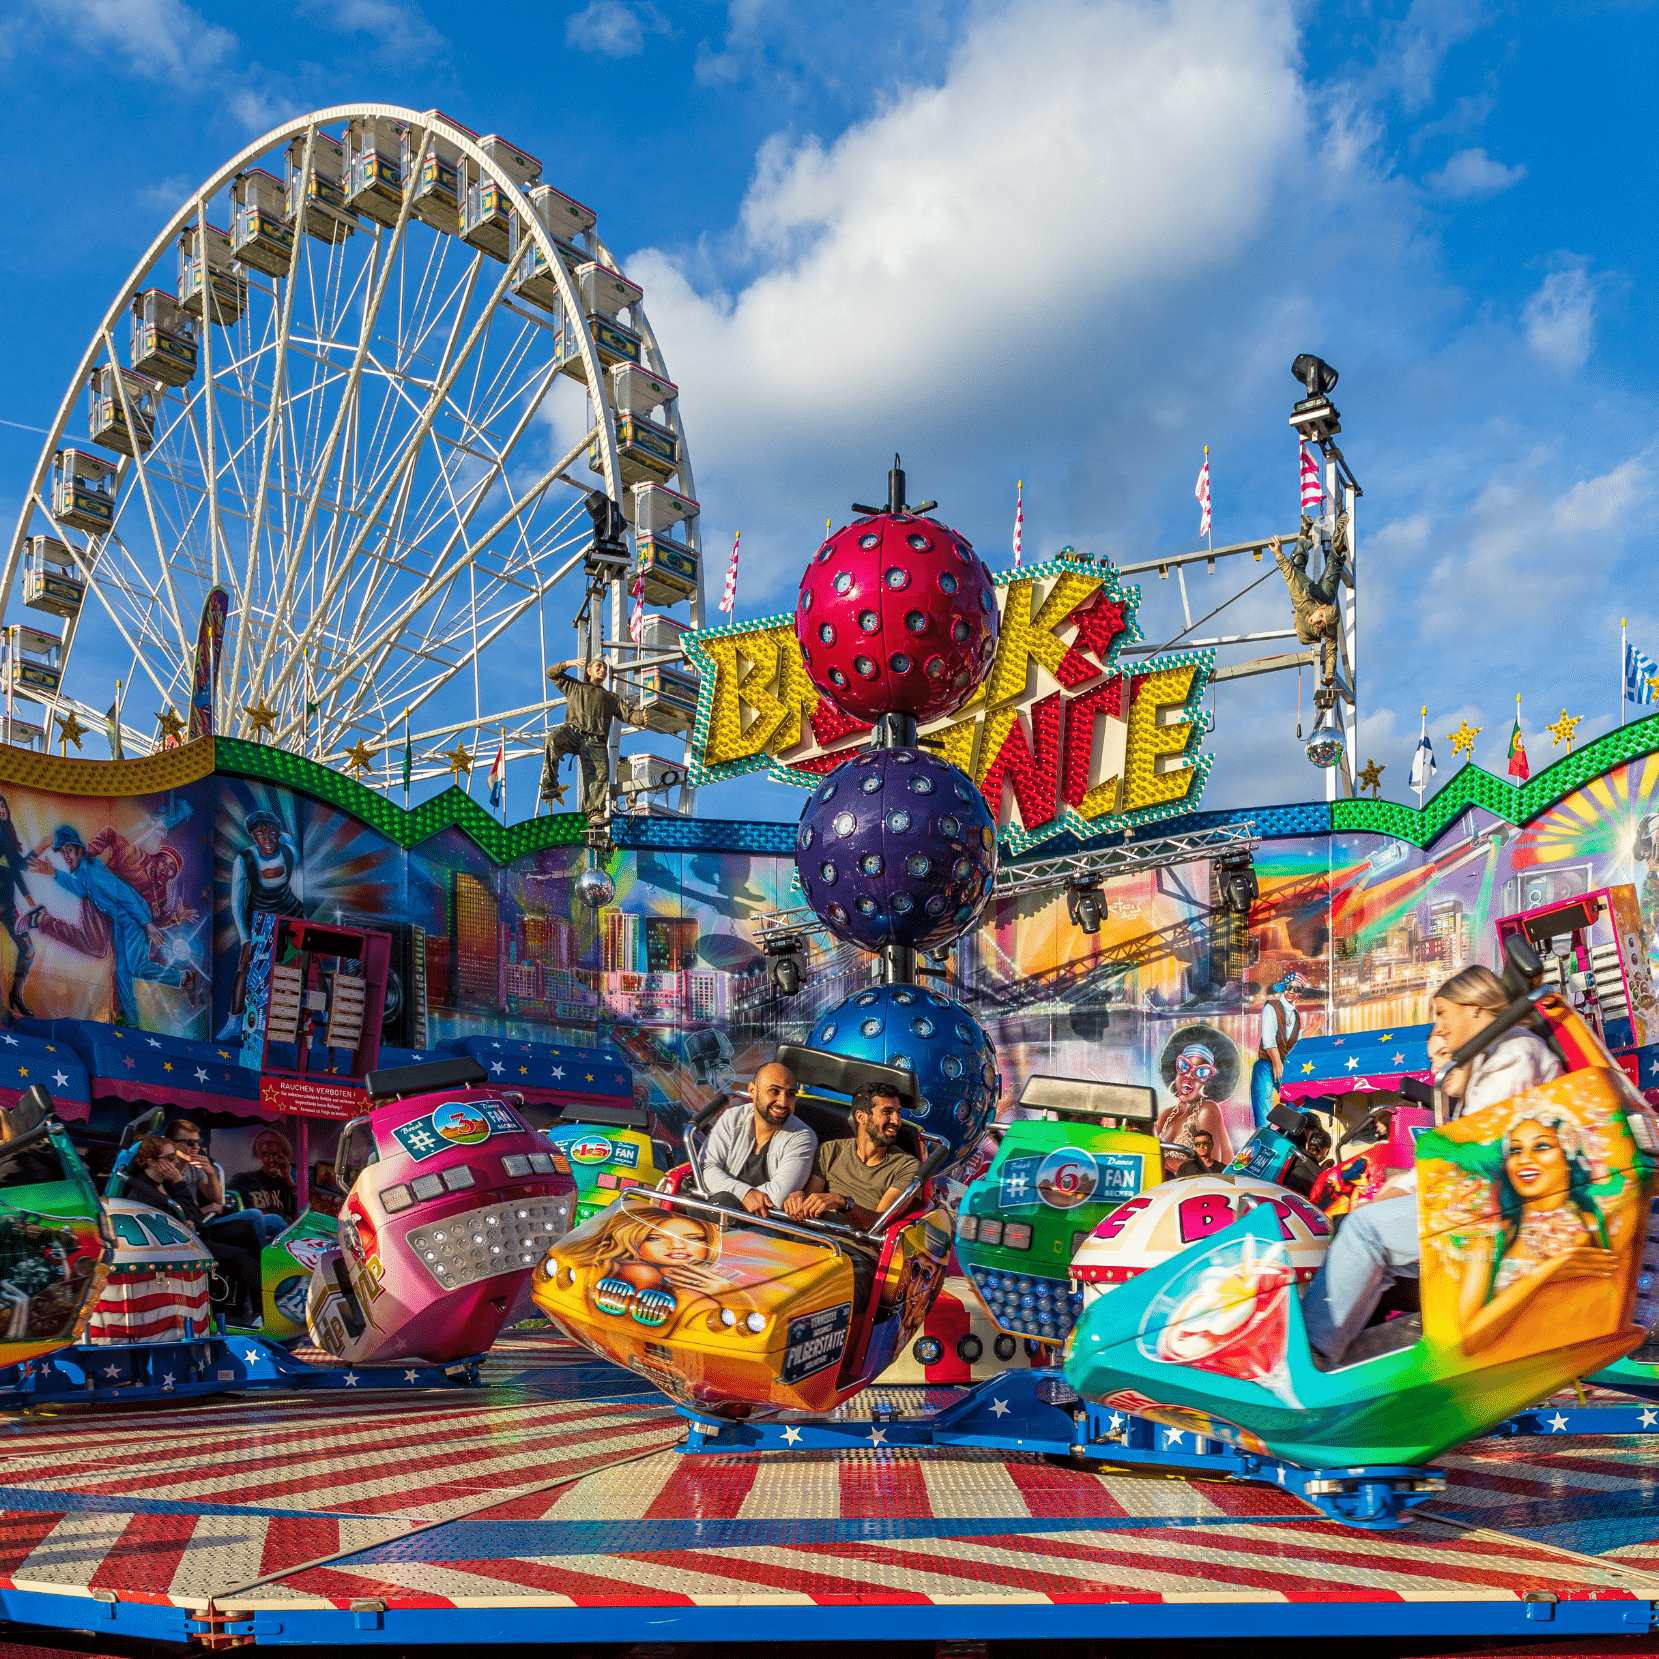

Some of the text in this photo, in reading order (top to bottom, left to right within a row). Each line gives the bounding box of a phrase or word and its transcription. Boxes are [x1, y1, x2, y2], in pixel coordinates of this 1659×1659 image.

[280, 1082, 315, 1093] RAUCHEN
[316, 1087, 352, 1098] VERBOTEN
[400, 1121, 424, 1135] Break
[449, 1112, 477, 1135] 3
[487, 1110, 513, 1123] FAN
[580, 1143, 608, 1157] 15
[615, 1148, 635, 1159] FAN
[1106, 1156, 1134, 1166] Dance
[1054, 1163, 1080, 1192] 6
[1105, 1169, 1135, 1188] FAN
